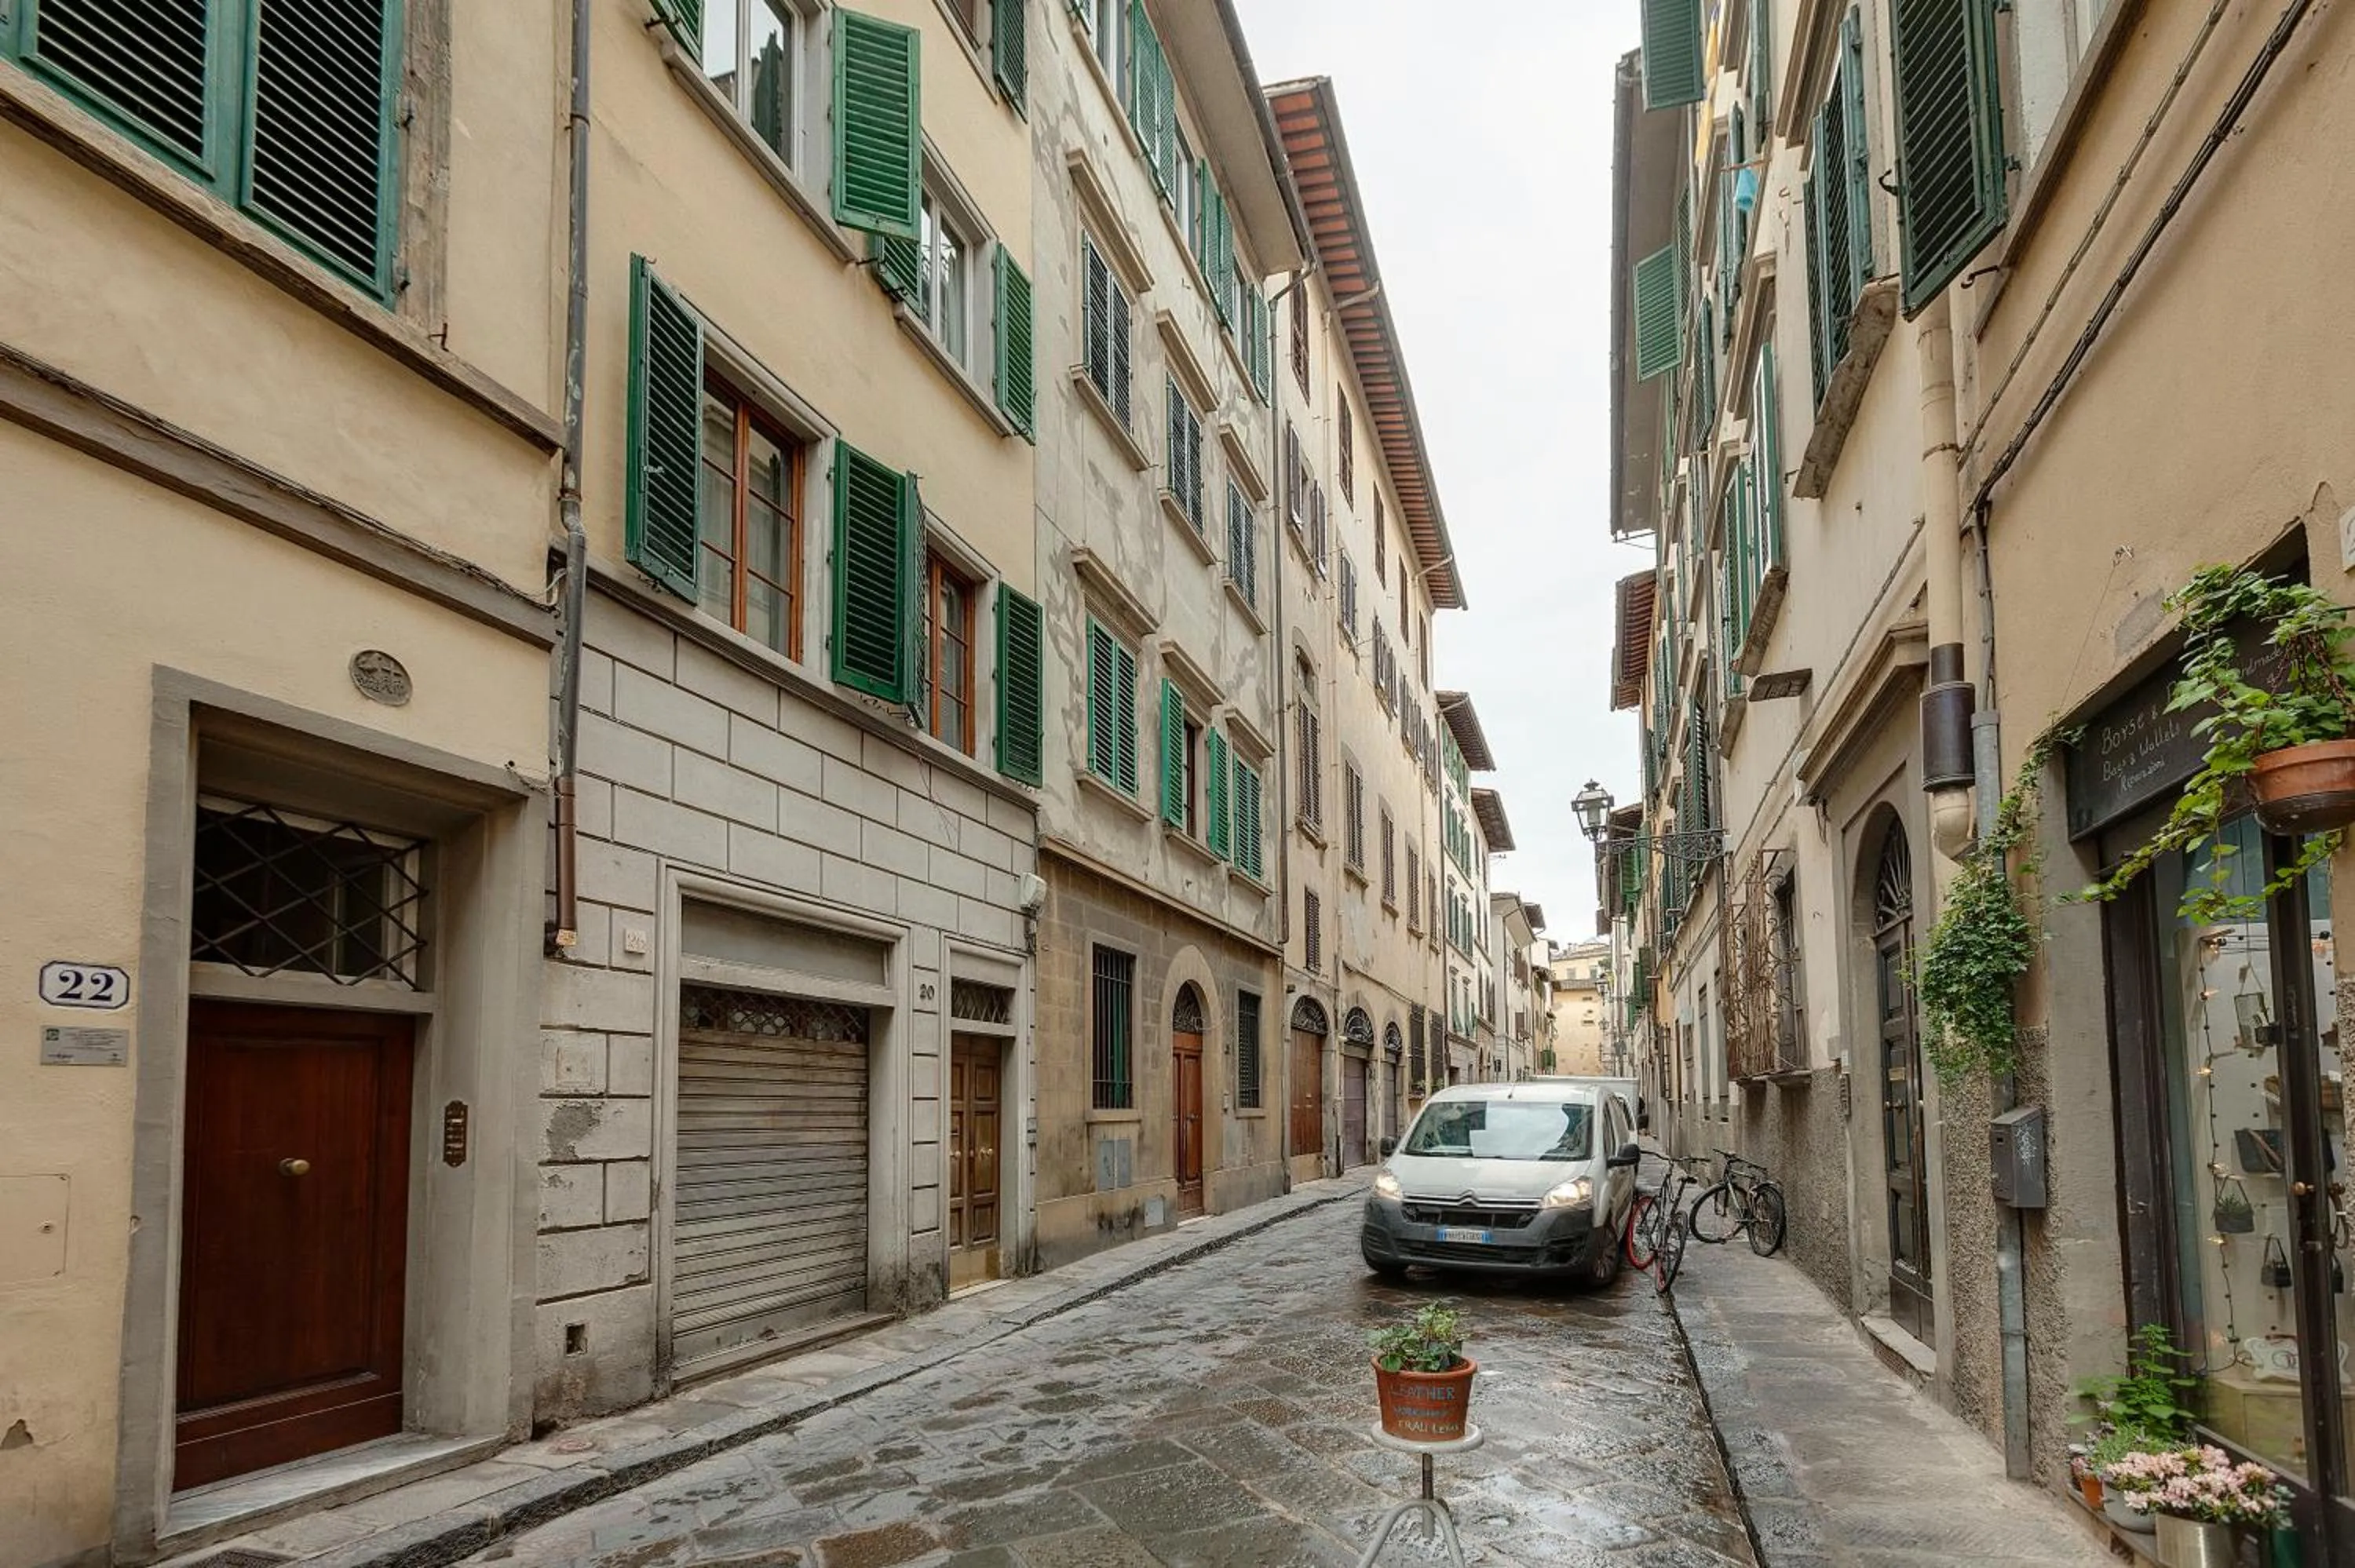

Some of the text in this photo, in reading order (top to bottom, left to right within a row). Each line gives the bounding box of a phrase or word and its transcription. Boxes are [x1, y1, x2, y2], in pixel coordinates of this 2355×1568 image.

[2101, 712, 2145, 754] Borse
[56, 969, 115, 1001] 22
[919, 983, 935, 1001] 20
